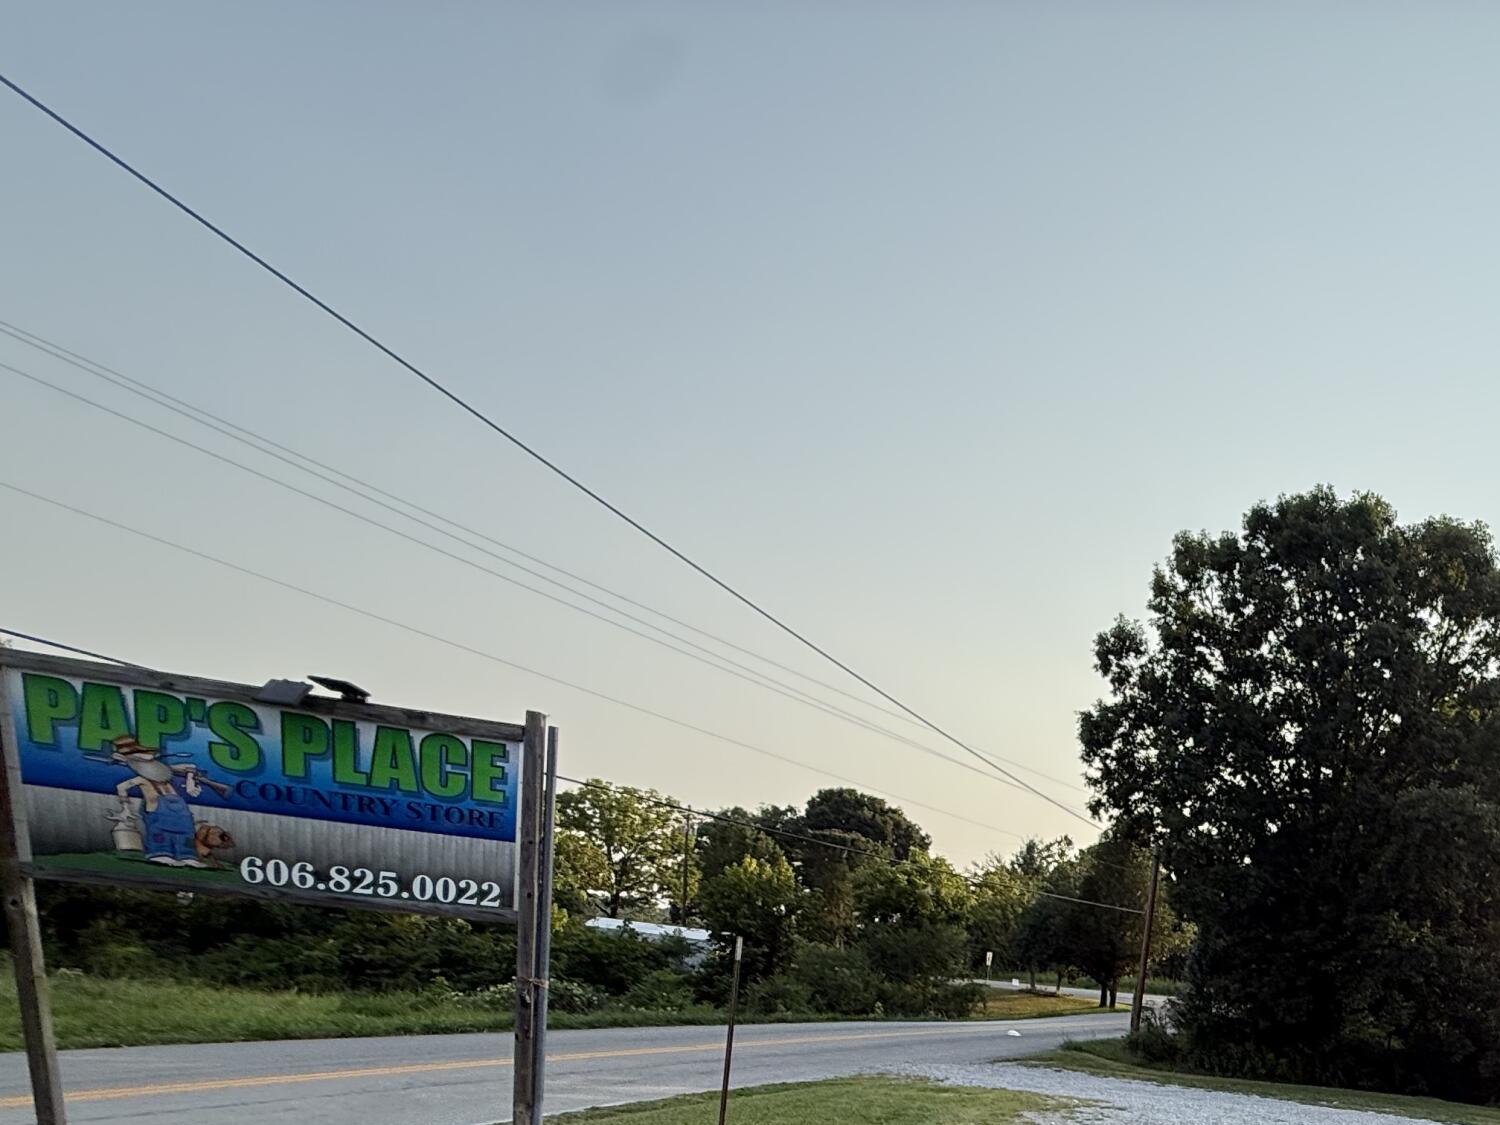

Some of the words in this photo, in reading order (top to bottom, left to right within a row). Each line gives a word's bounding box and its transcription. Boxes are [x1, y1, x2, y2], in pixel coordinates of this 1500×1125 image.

[22, 672, 264, 772] PAP'S
[280, 711, 509, 804] PLACE
[235, 779, 397, 818] COUNTRY
[406, 801, 504, 829] STORE
[240, 856, 501, 908] 606.825.0022
